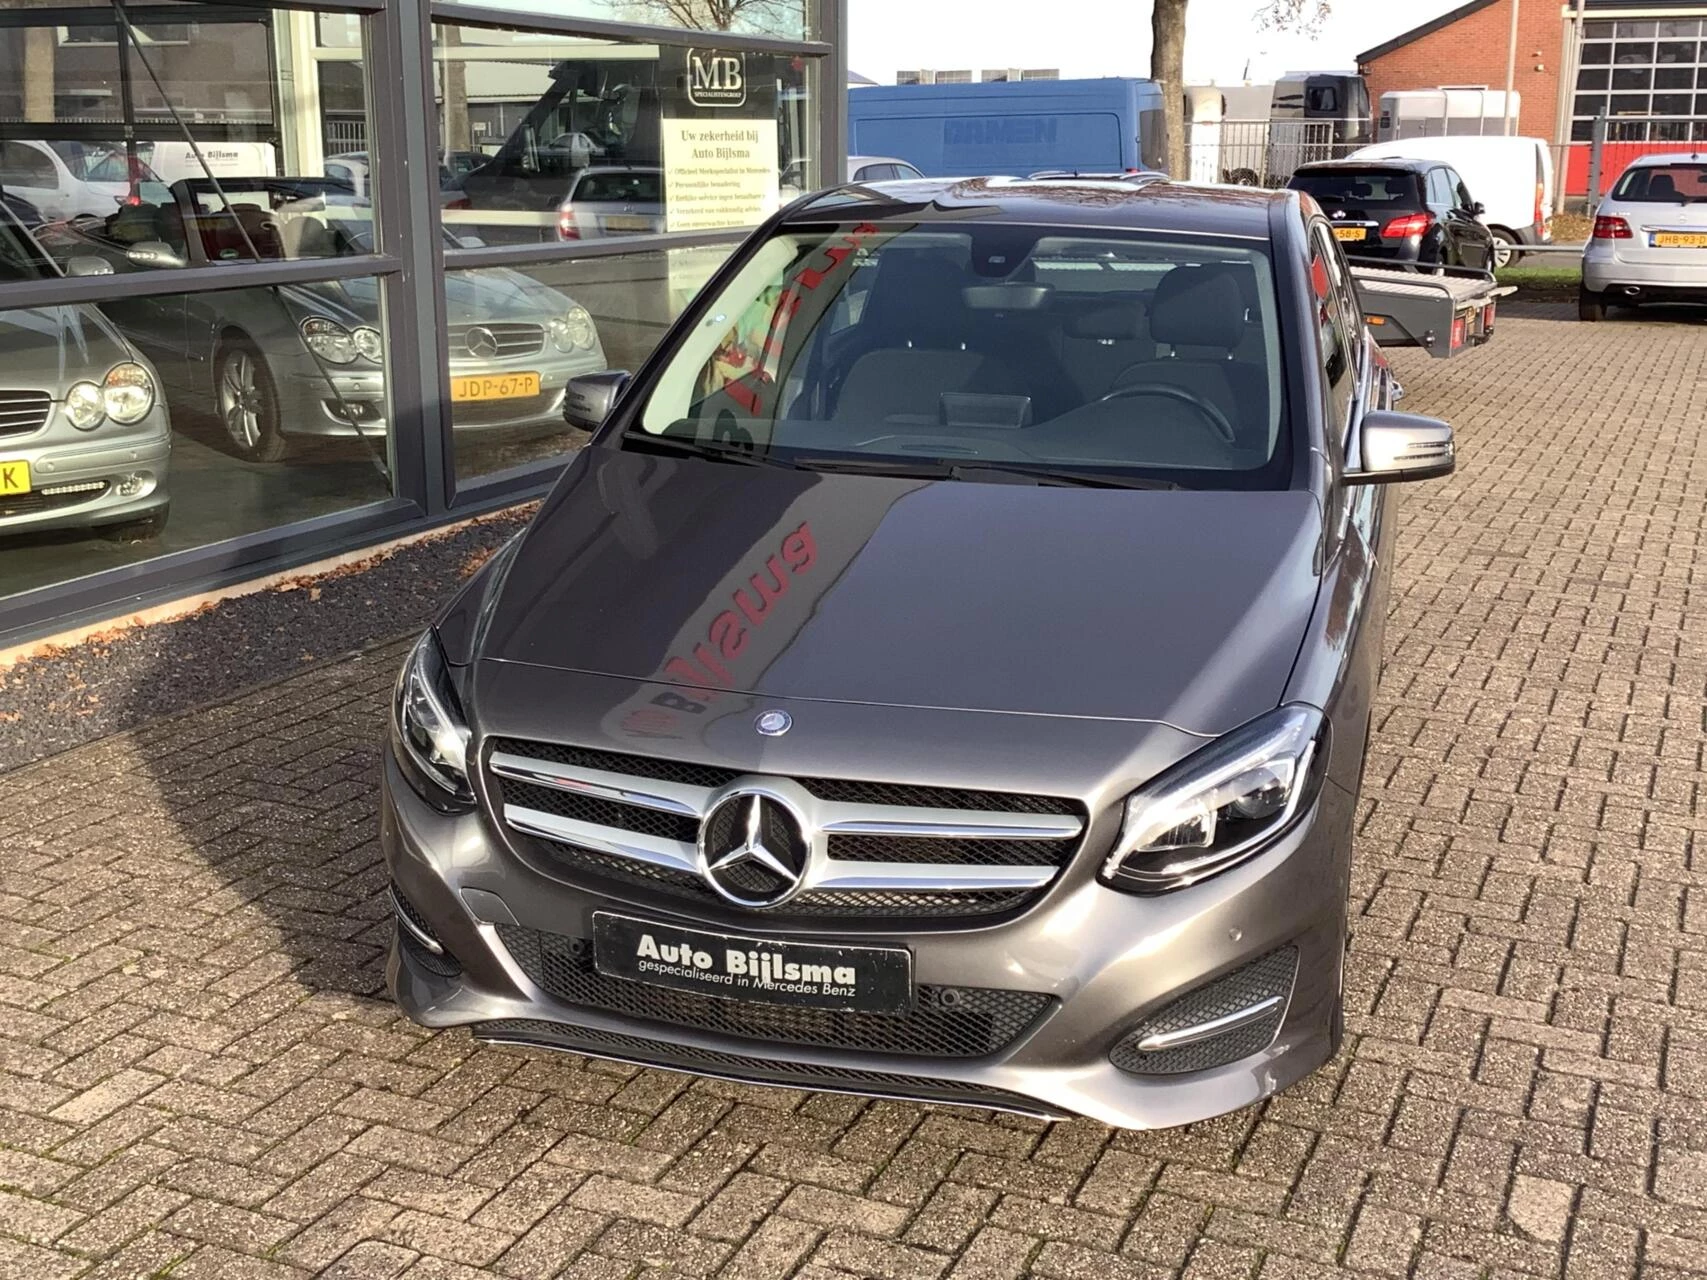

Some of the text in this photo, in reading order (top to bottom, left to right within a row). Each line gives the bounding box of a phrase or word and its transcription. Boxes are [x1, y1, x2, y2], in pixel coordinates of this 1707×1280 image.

[692, 56, 742, 90] MB
[681, 130, 759, 144] Uw zekerheid bij
[692, 147, 751, 160] Auto Bijlsma
[459, 376, 533, 398] JDP-67-P
[2, 466, 19, 490] K
[636, 934, 857, 986] Auto Bijlsma
[638, 958, 857, 997] gespecialiseerd in Mercedes Benz
